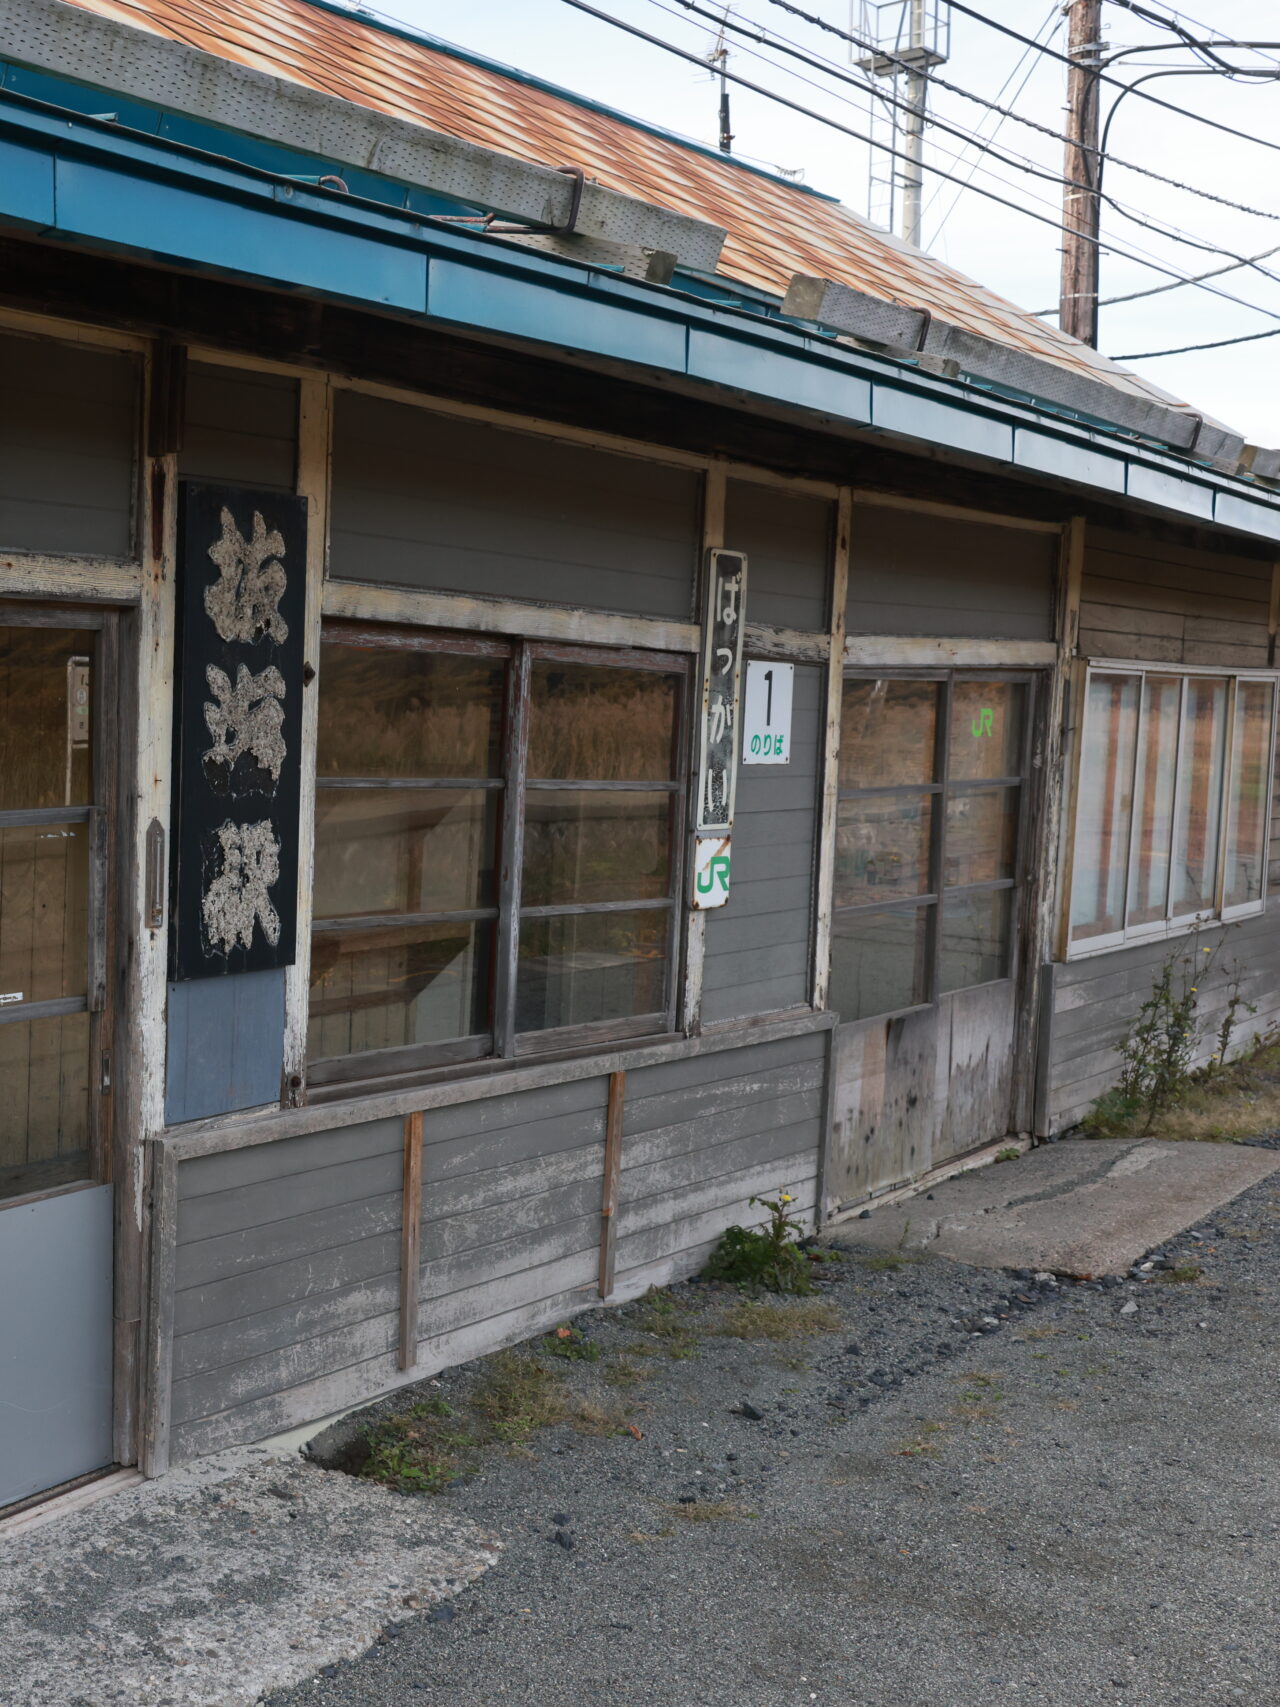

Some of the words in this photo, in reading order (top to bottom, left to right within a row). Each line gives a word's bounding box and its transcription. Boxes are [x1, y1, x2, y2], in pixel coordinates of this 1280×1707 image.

[764, 670, 773, 726] 1
[971, 708, 994, 738] JR
[750, 733, 785, 756] のりば
[696, 855, 731, 895] JR
